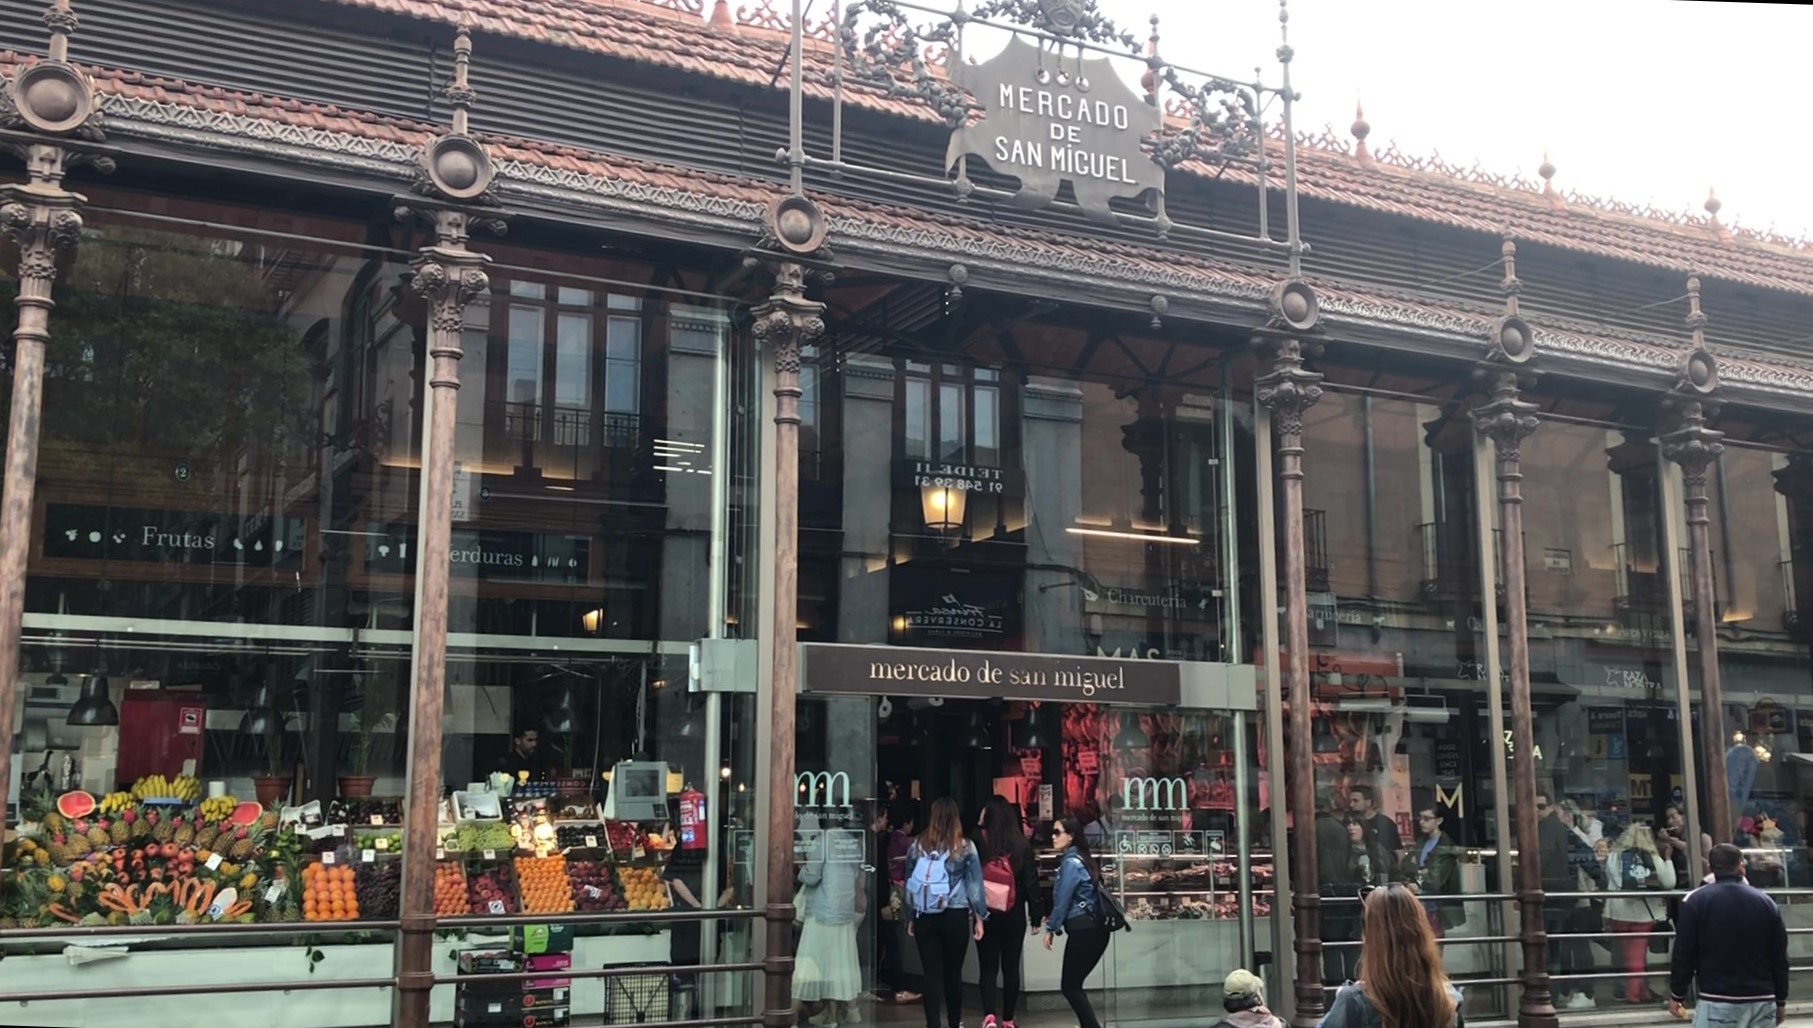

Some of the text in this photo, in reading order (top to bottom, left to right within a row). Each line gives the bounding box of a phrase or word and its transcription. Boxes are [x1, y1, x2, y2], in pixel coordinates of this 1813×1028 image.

[1000, 83, 1128, 130] MERCADO
[1050, 123, 1081, 144] DE
[995, 136, 1043, 168] SAN
[141, 525, 215, 550] Frutas
[445, 545, 524, 567] erduras
[868, 659, 1126, 697] mercado de san miguel
